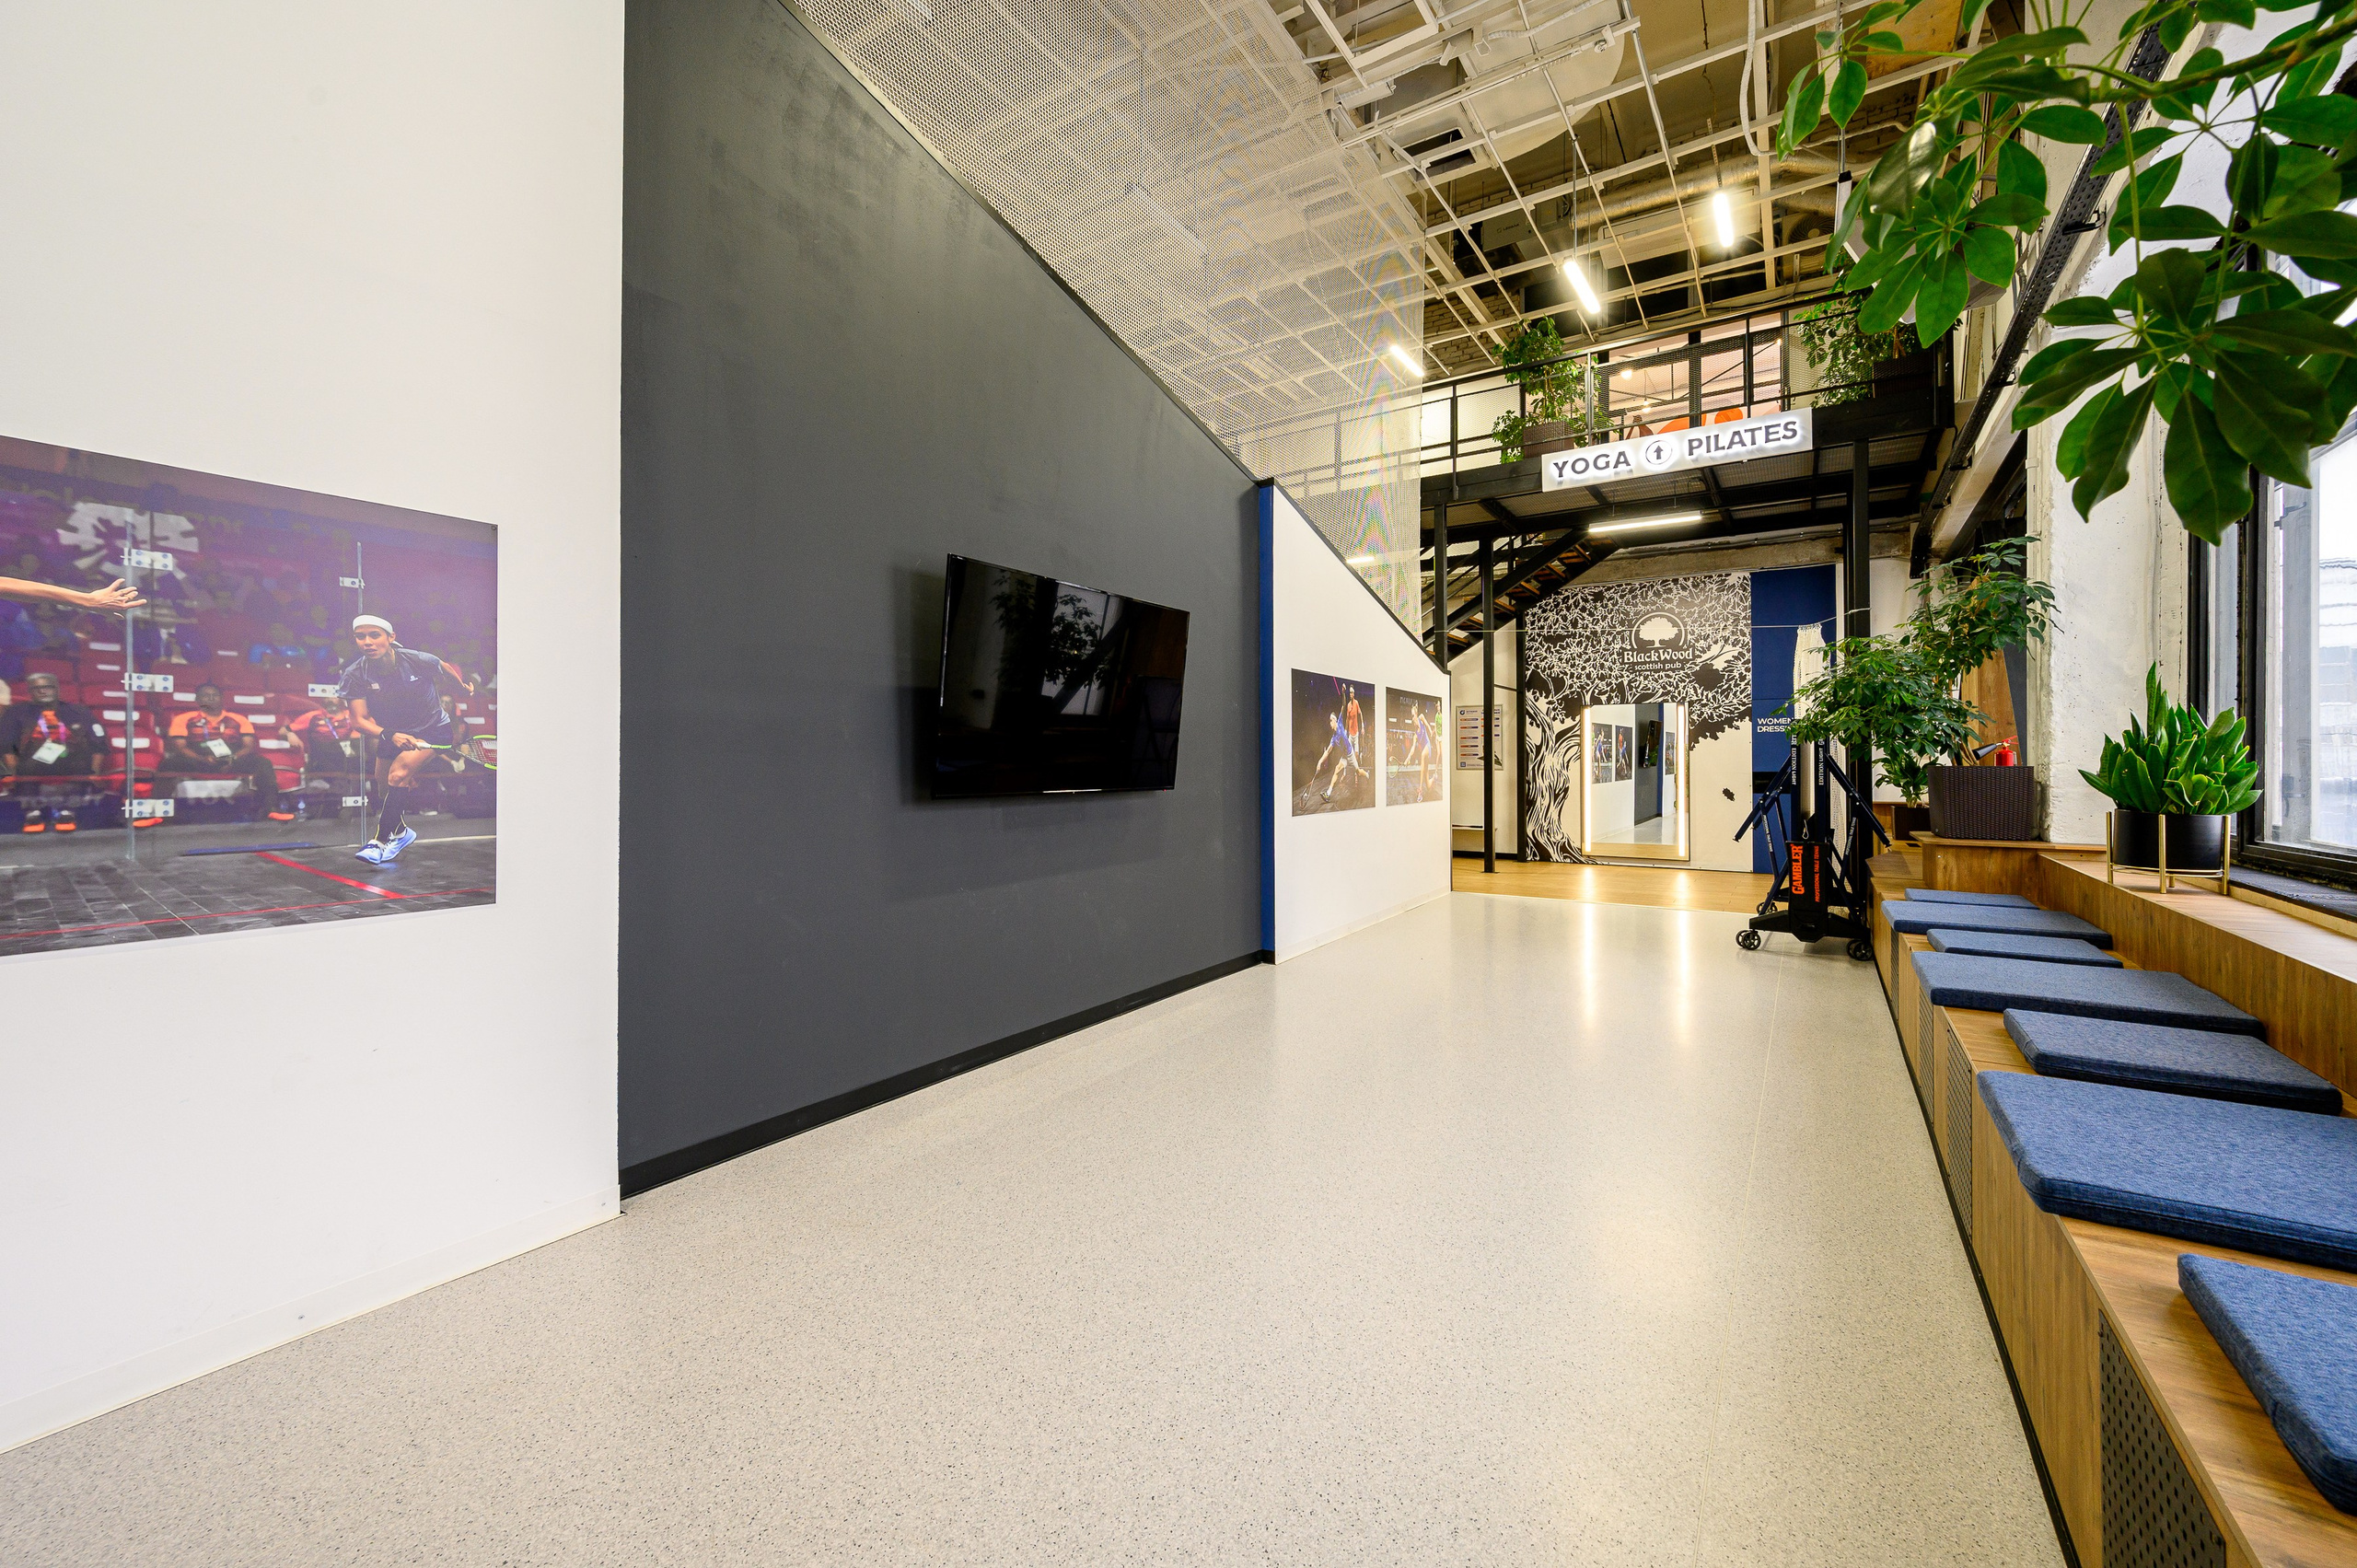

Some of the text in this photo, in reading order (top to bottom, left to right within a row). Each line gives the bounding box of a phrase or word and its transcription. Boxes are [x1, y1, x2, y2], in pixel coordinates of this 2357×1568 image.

[1552, 421, 1798, 478] YOGA PILATES
[1623, 647, 1693, 663] BlackWood
[1634, 661, 1682, 670] scottish pub
[1791, 844, 1805, 895] GAMBLER
